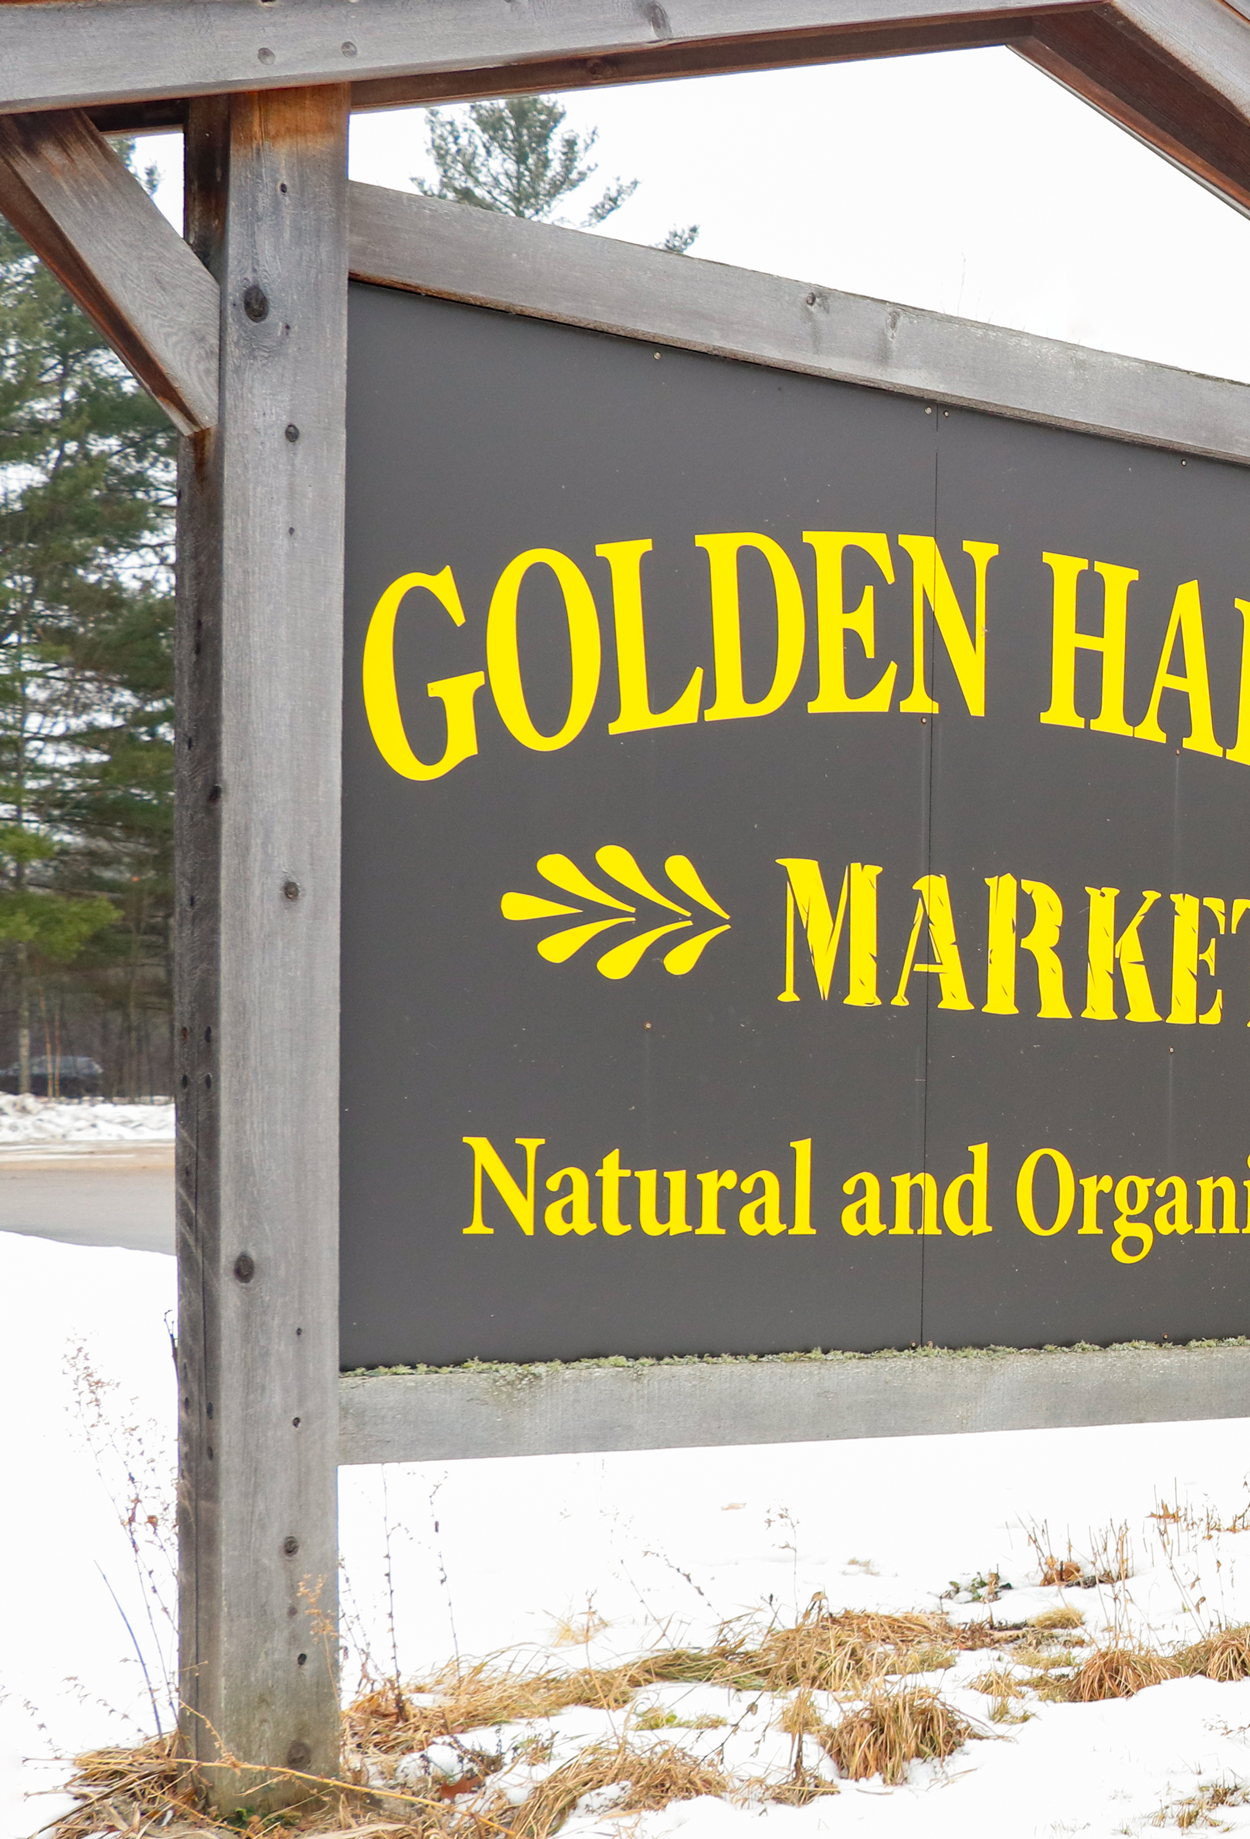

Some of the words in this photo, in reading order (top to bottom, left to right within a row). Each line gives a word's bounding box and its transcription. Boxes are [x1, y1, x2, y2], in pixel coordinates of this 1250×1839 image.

[362, 531, 999, 783] GOLDEN
[462, 1136, 817, 1237] Natural
[841, 1142, 993, 1237] and
